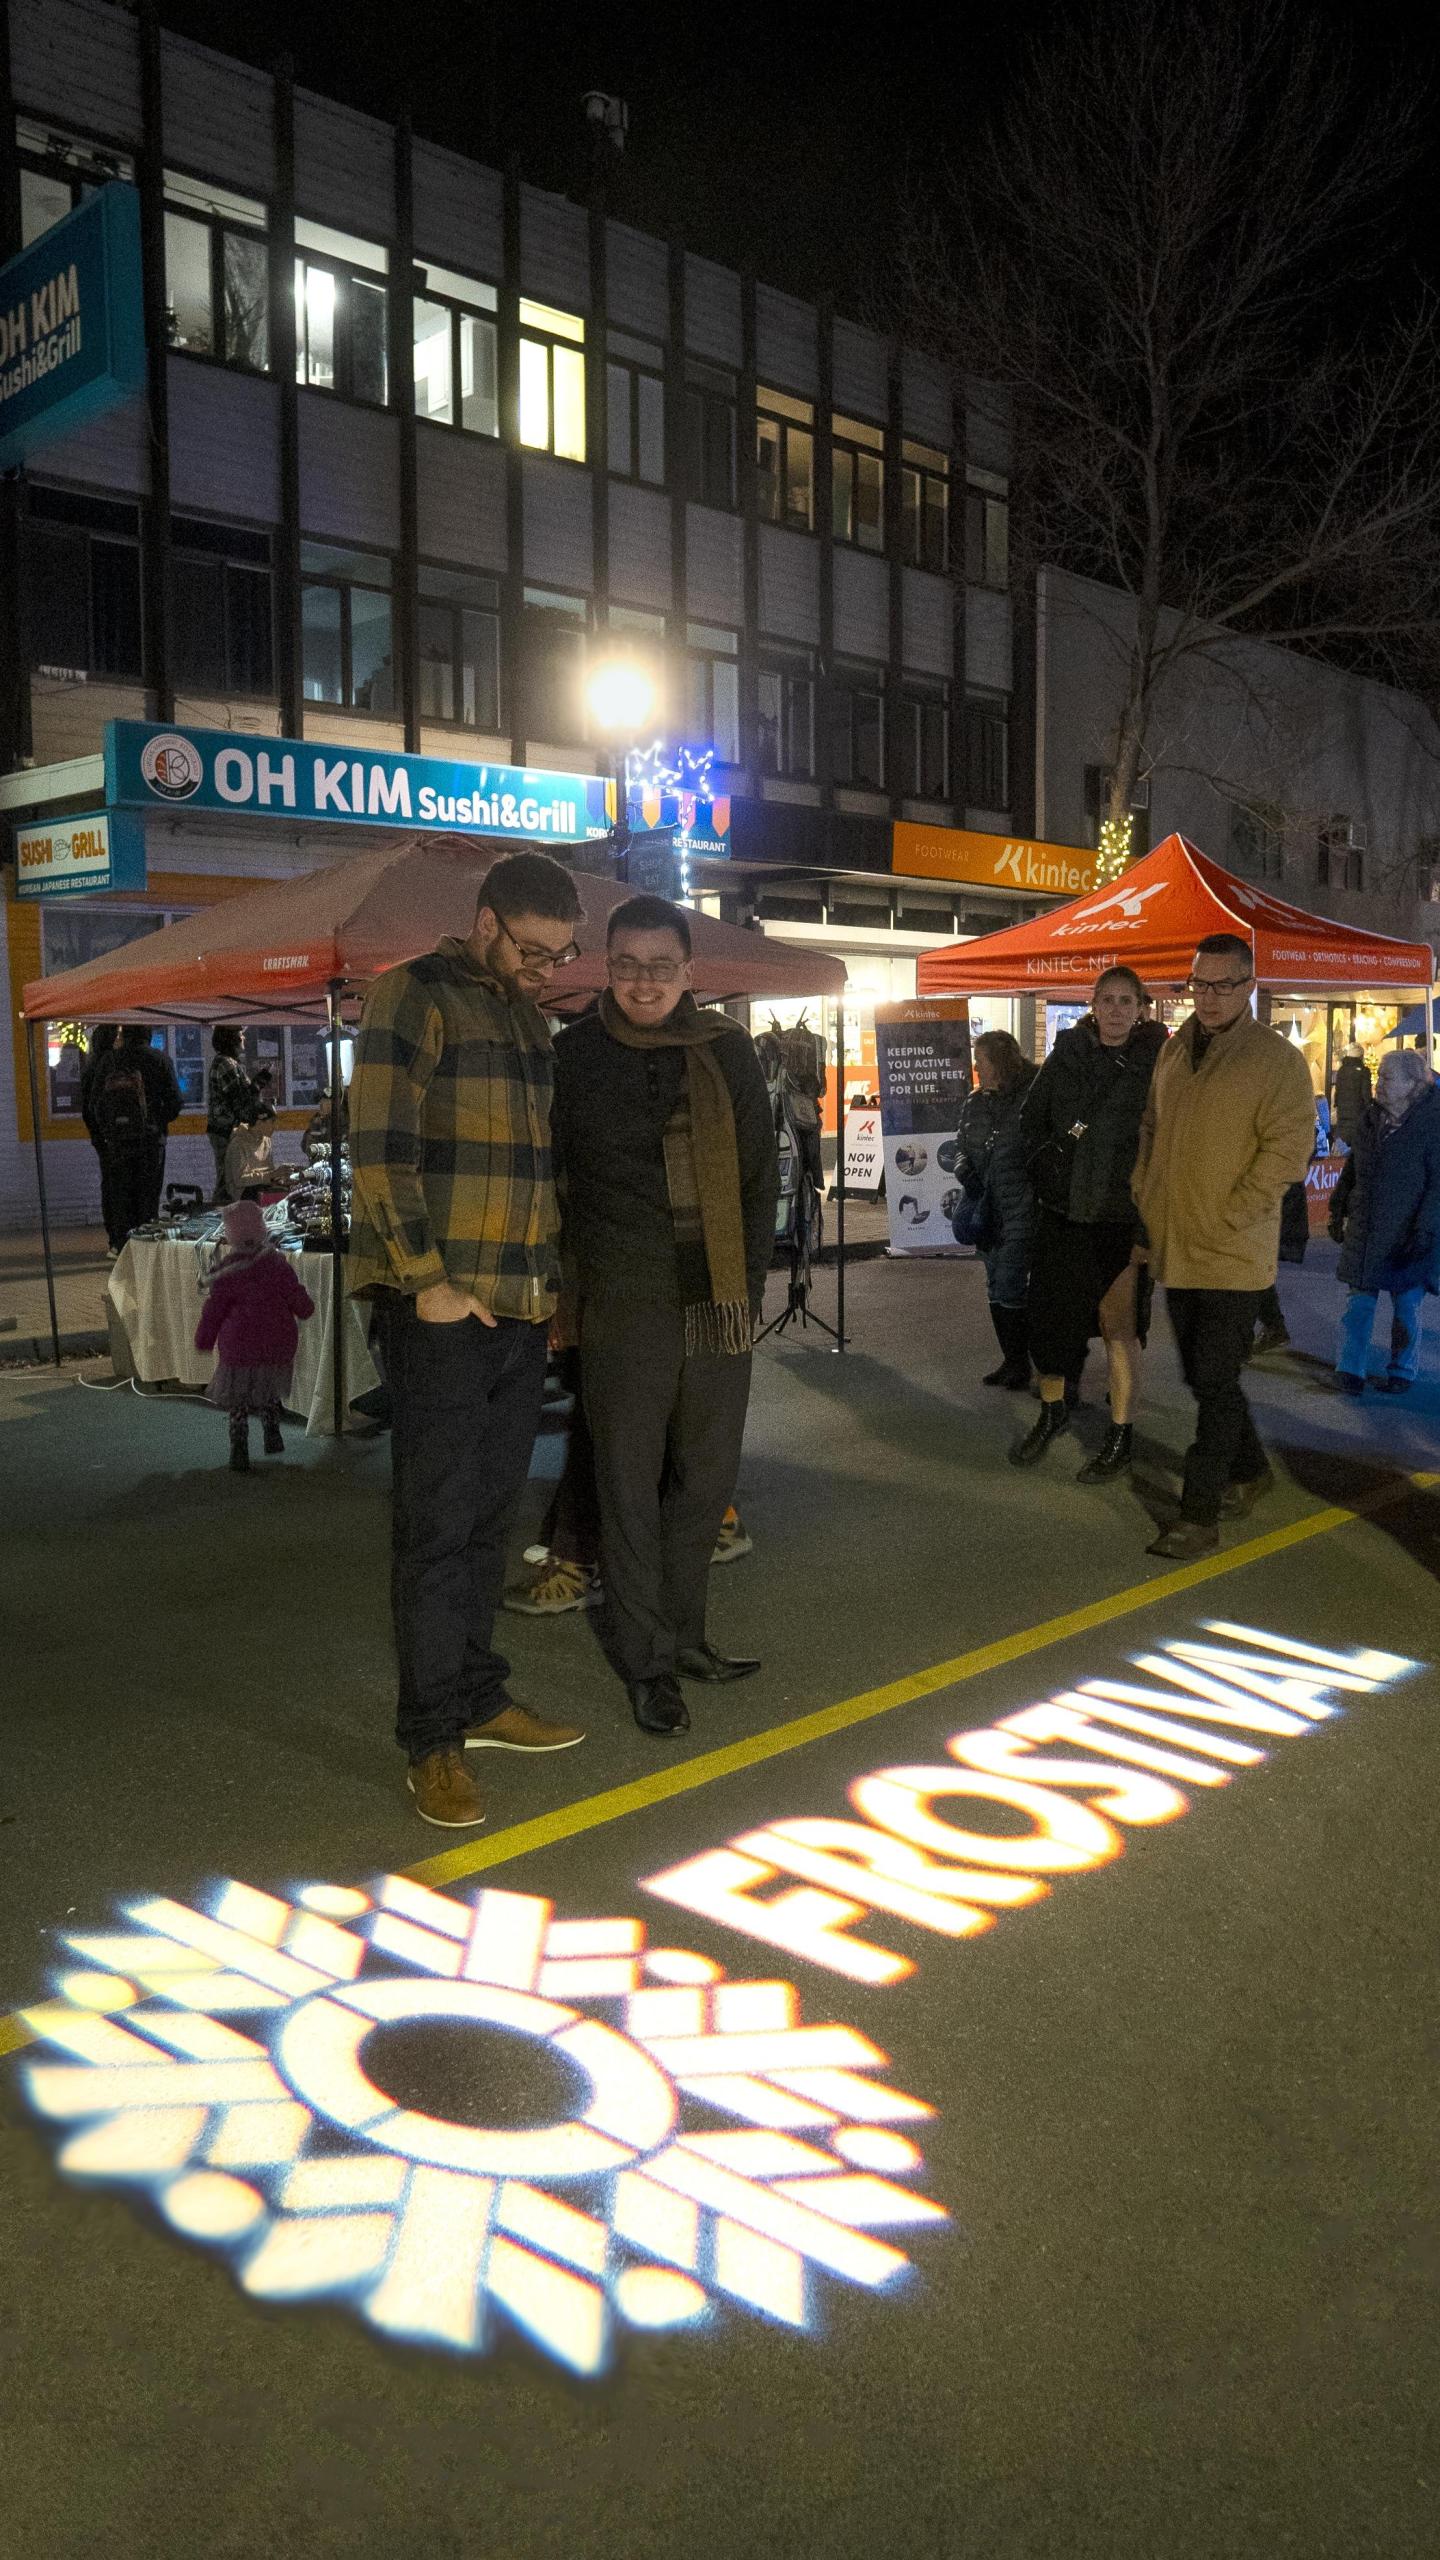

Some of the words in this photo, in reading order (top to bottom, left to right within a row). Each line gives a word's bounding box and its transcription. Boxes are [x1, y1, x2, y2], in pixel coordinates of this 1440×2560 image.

[32, 263, 80, 341] KIM
[0, 315, 81, 400] ushi&Grill
[214, 748, 296, 807] OH
[314, 758, 413, 818] KIM
[418, 786, 576, 834] Sushi&Grill
[586, 826, 615, 838] KOR
[21, 838, 53, 867] SUSHI
[71, 829, 106, 860] GRILL
[672, 836, 727, 853] RESTAURANT
[914, 843, 969, 863] FOOTWEAR
[1026, 846, 1092, 891] kintec
[42, 878, 70, 891] JAPANESE
[70, 874, 111, 888] RESTAURANT
[1050, 918, 1149, 937] kintec
[263, 954, 310, 971] CRAFTSMAN
[1026, 953, 1120, 975] KINTEC.NET
[1272, 950, 1307, 961] FOOTWEAR
[1313, 951, 1347, 964] ORTHOTICS
[1383, 956, 1421, 969] COMPRESSION
[915, 1009, 941, 1018] kintec
[887, 1046, 934, 1057] KEEPING
[888, 1060, 911, 1070] YOU
[914, 1058, 951, 1068] ACTIVE
[889, 1073, 906, 1082] ON
[909, 1071, 938, 1081] YOUR
[941, 1070, 966, 1080] FEET,
[890, 1085, 911, 1095] FOR
[914, 1084, 939, 1094] LIFE.
[856, 1133, 875, 1142] kintec
[847, 1153, 875, 1163] NOW
[844, 1167, 873, 1178] OPEN
[638, 1618, 1422, 1986] FROSTIVAL
